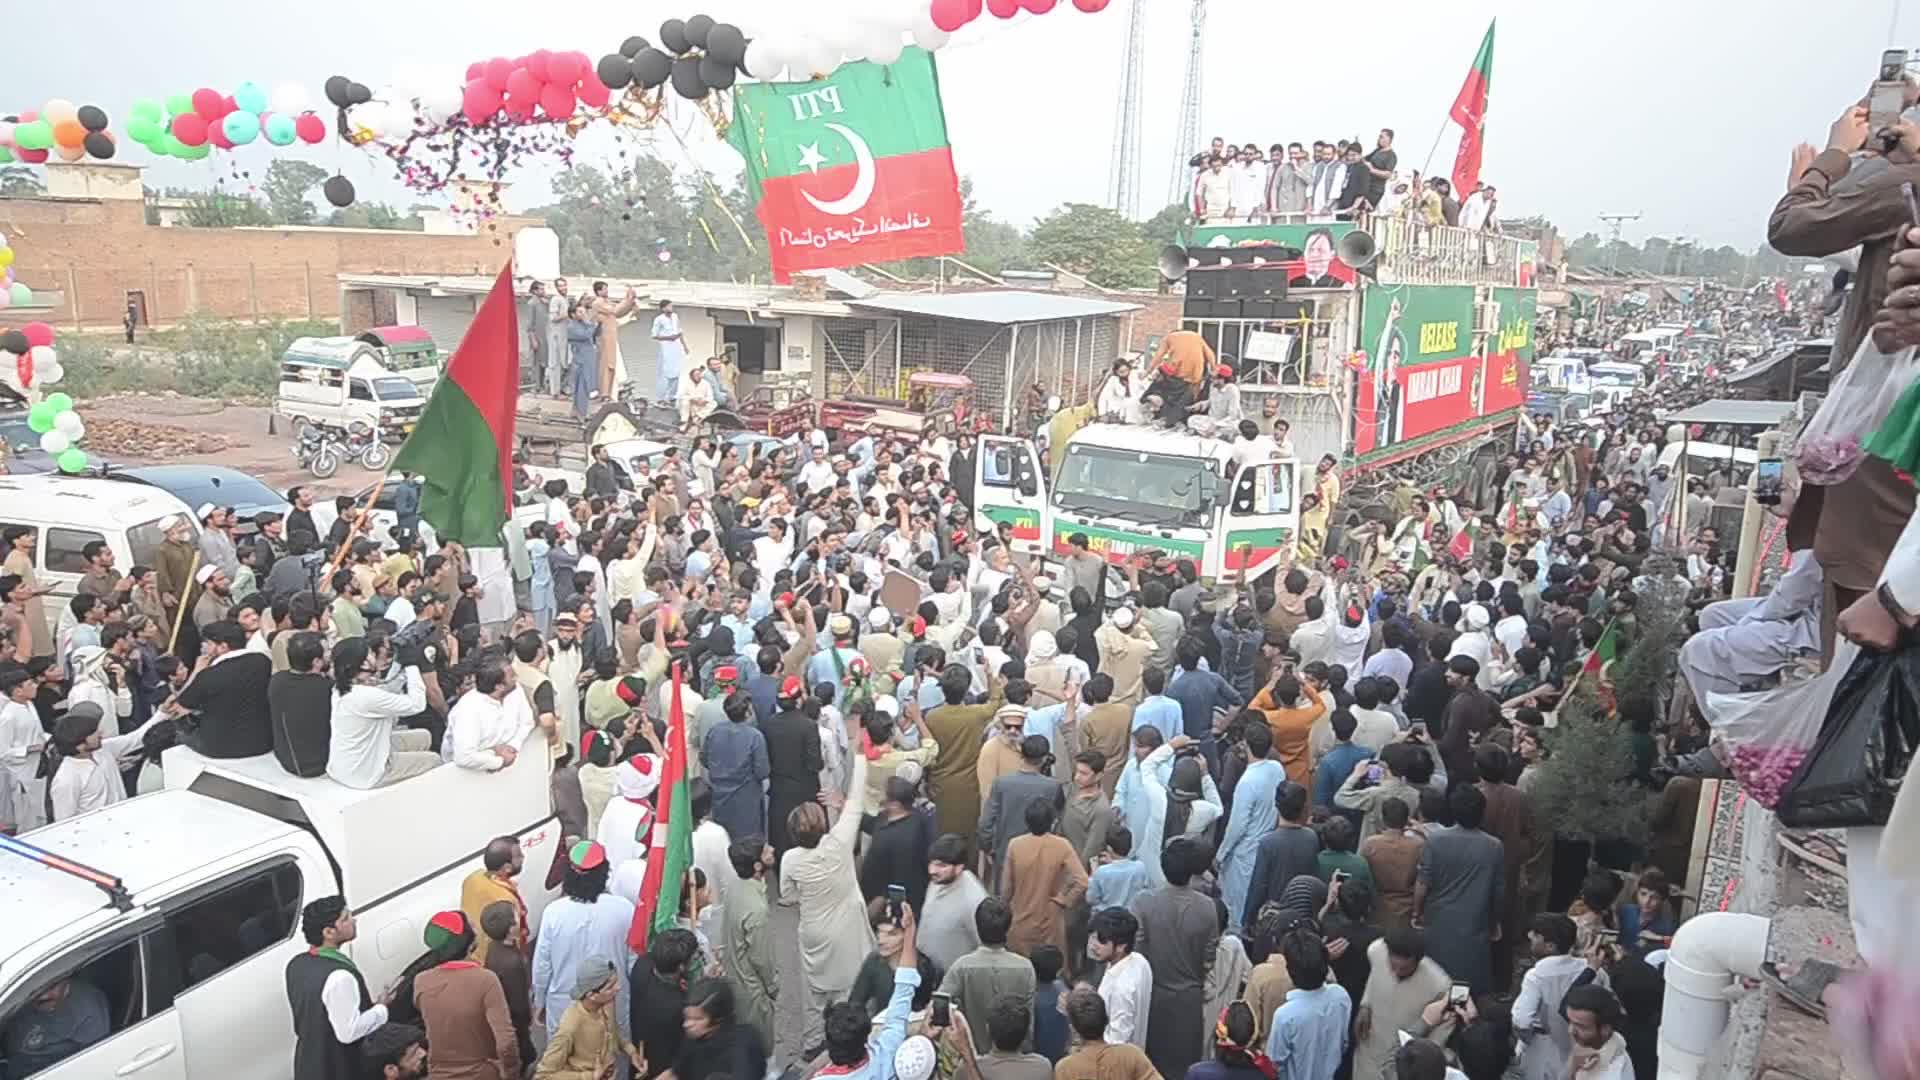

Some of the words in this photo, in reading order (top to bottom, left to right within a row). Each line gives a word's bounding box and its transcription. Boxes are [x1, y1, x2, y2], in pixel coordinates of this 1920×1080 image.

[1419, 321, 1458, 354] RELEASE
[1407, 369, 1439, 404] IMRAN
[1437, 364, 1463, 397] KHAN
